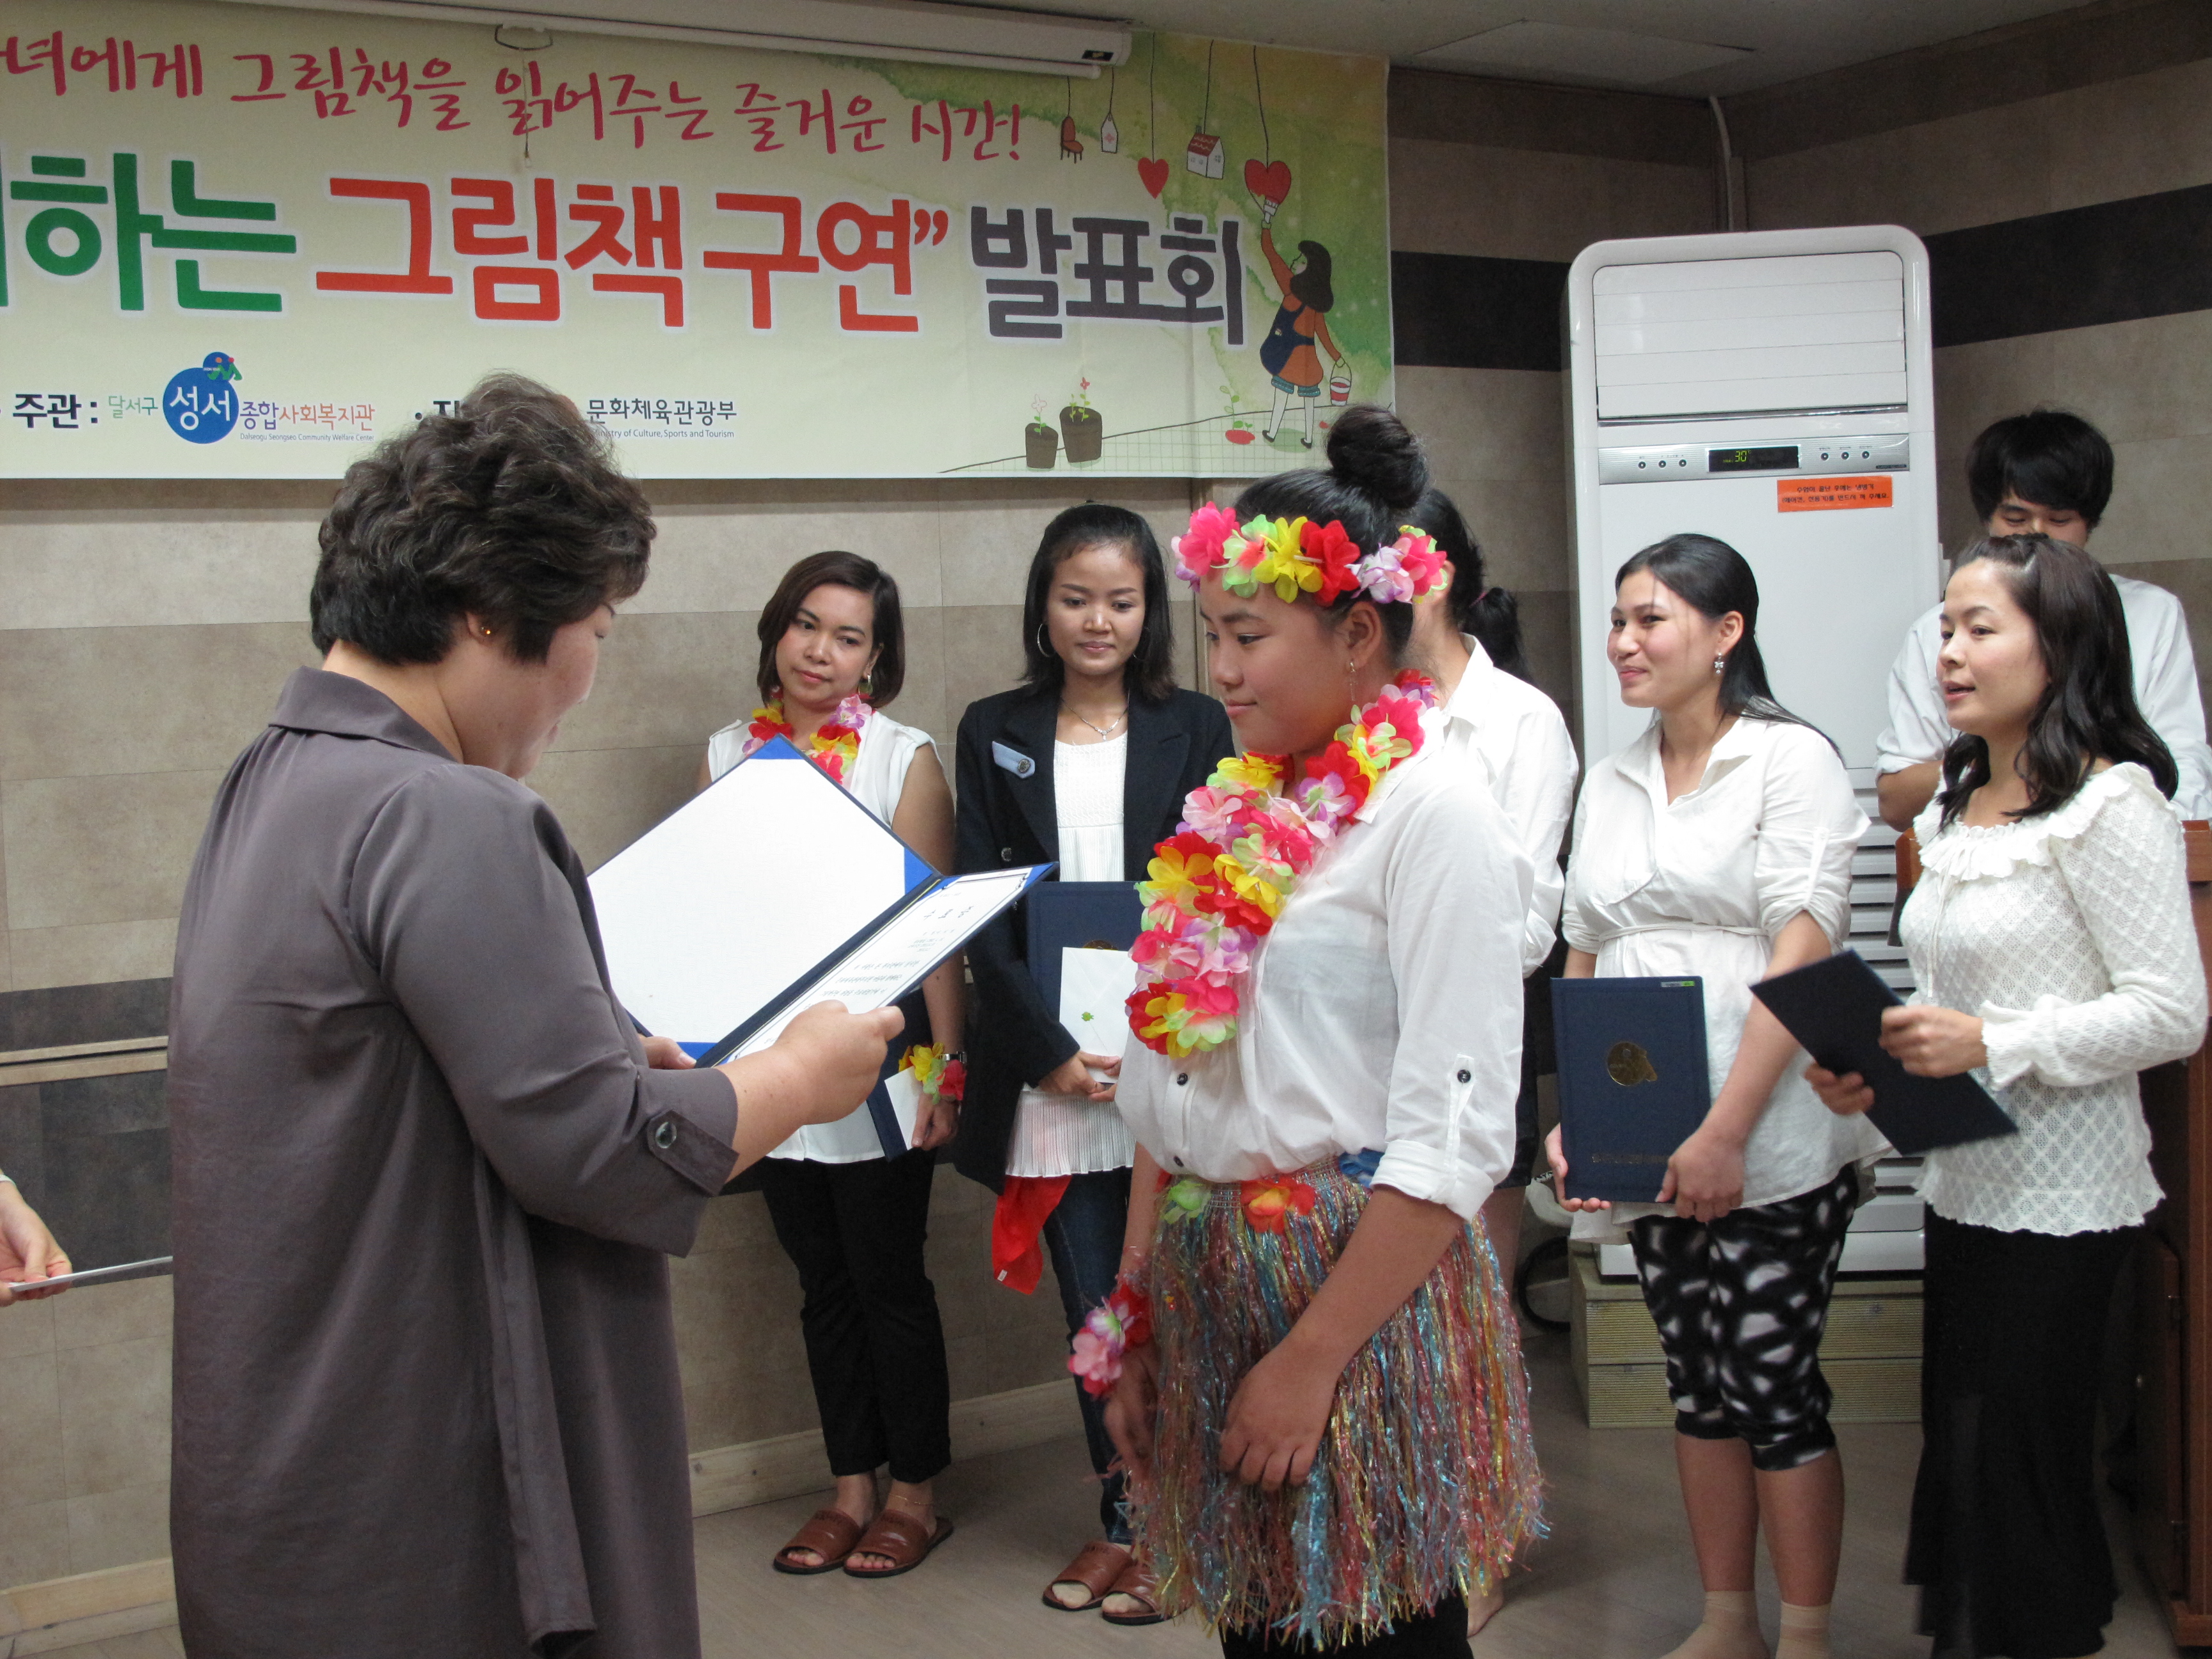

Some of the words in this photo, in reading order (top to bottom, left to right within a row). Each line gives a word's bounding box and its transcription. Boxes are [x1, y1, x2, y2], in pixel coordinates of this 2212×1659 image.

[230, 46, 471, 131] 그림책을
[494, 61, 714, 149] 읽어주는
[734, 83, 888, 154] 즐거운
[911, 99, 1021, 161] 시간!
[316, 177, 684, 327] 그림책
[970, 205, 1244, 346] 발표회
[108, 395, 159, 419] 달서구
[586, 397, 737, 426] 문화체육관광부
[239, 433, 268, 442] Dalseogu
[268, 433, 297, 442] Seongseo
[298, 433, 331, 442] Community
[664, 429, 688, 439] Sports
[705, 429, 734, 438] Tourism
